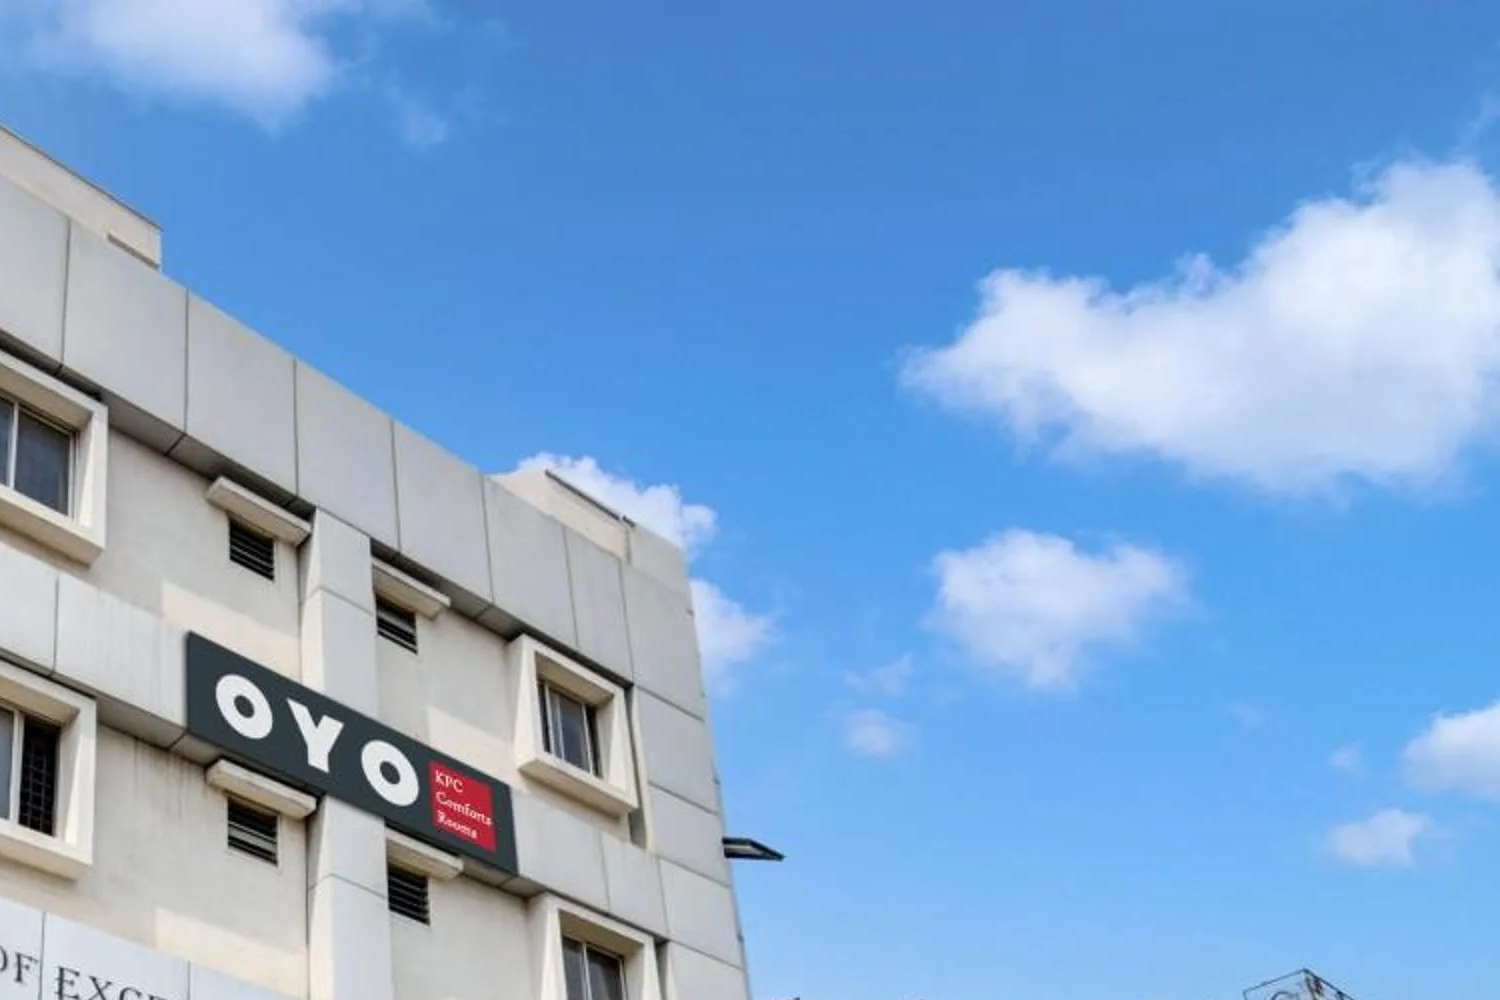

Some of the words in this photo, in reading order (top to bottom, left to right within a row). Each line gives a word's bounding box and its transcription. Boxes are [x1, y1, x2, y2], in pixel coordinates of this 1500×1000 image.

[216, 674, 420, 807] OYO
[435, 769, 463, 793] KPC
[435, 791, 493, 827] Comforts
[437, 809, 478, 840] Rooms
